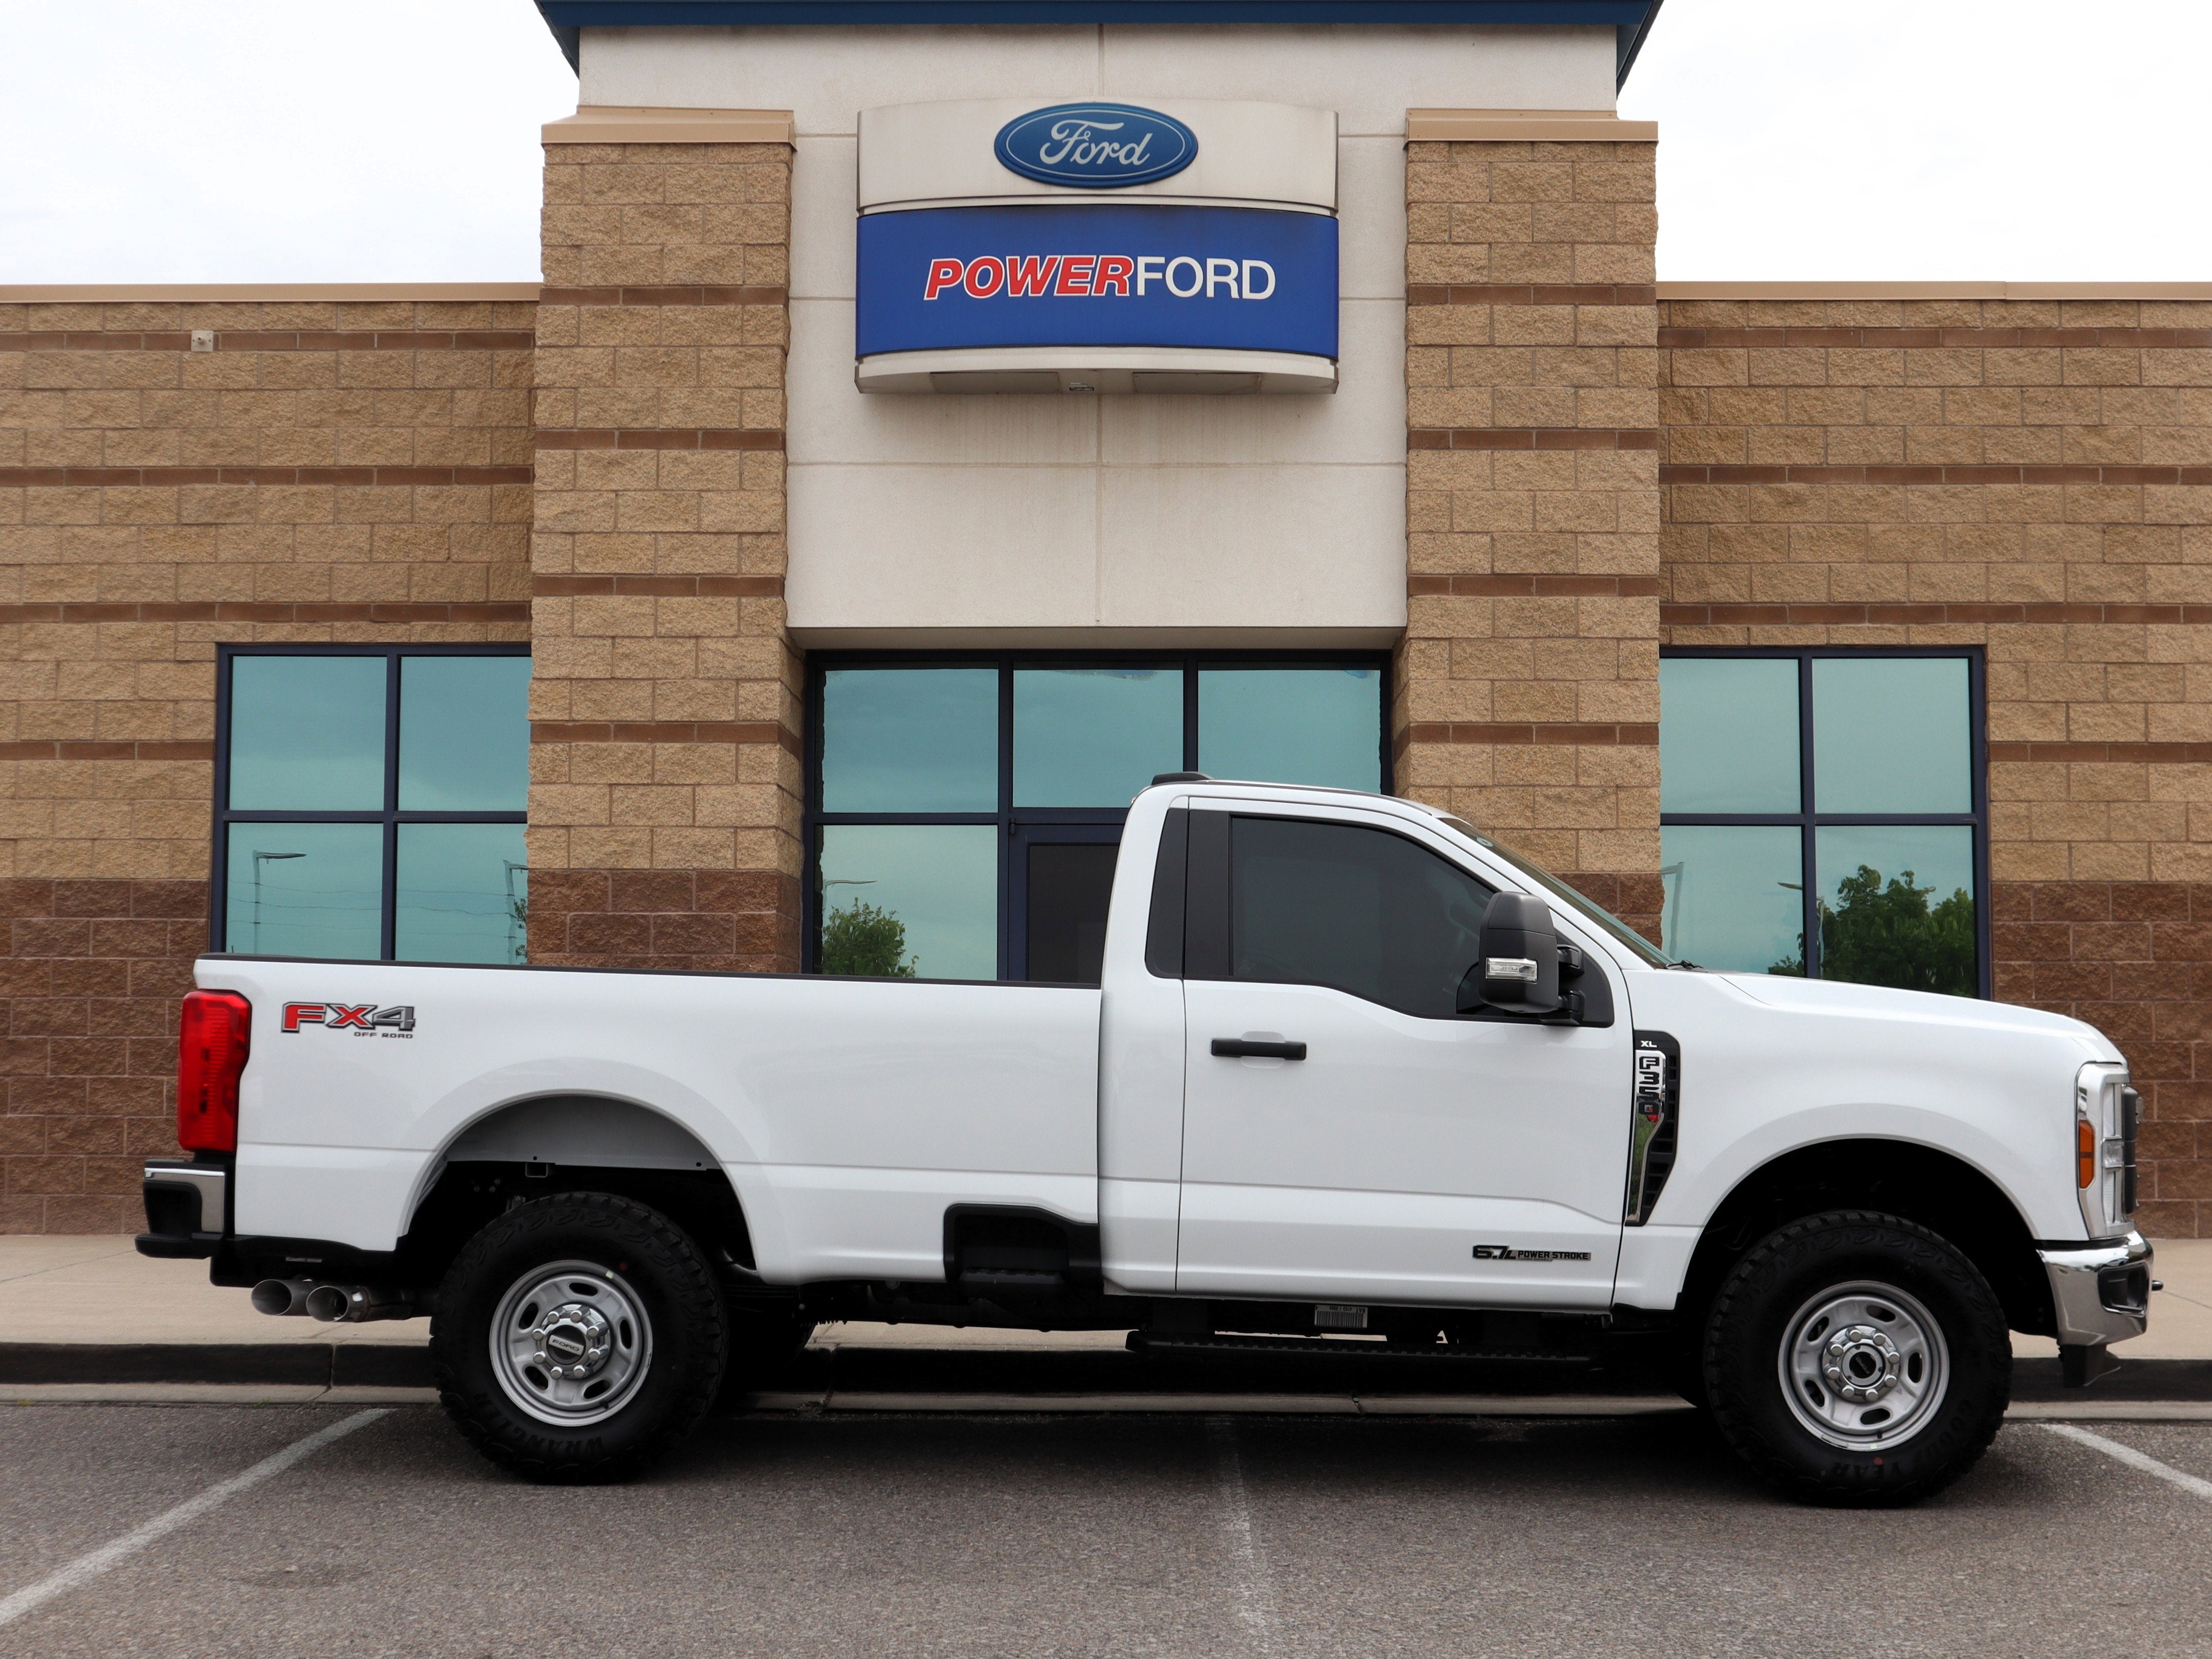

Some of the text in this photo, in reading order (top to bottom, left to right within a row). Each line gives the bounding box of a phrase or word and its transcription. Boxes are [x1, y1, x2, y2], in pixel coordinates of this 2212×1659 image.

[1040, 119, 1153, 166] Ford
[280, 1002, 415, 1034] FX4
[1473, 1245, 1589, 1260] 6.7L POWER STROKE
[552, 1339, 580, 1351] FORD
